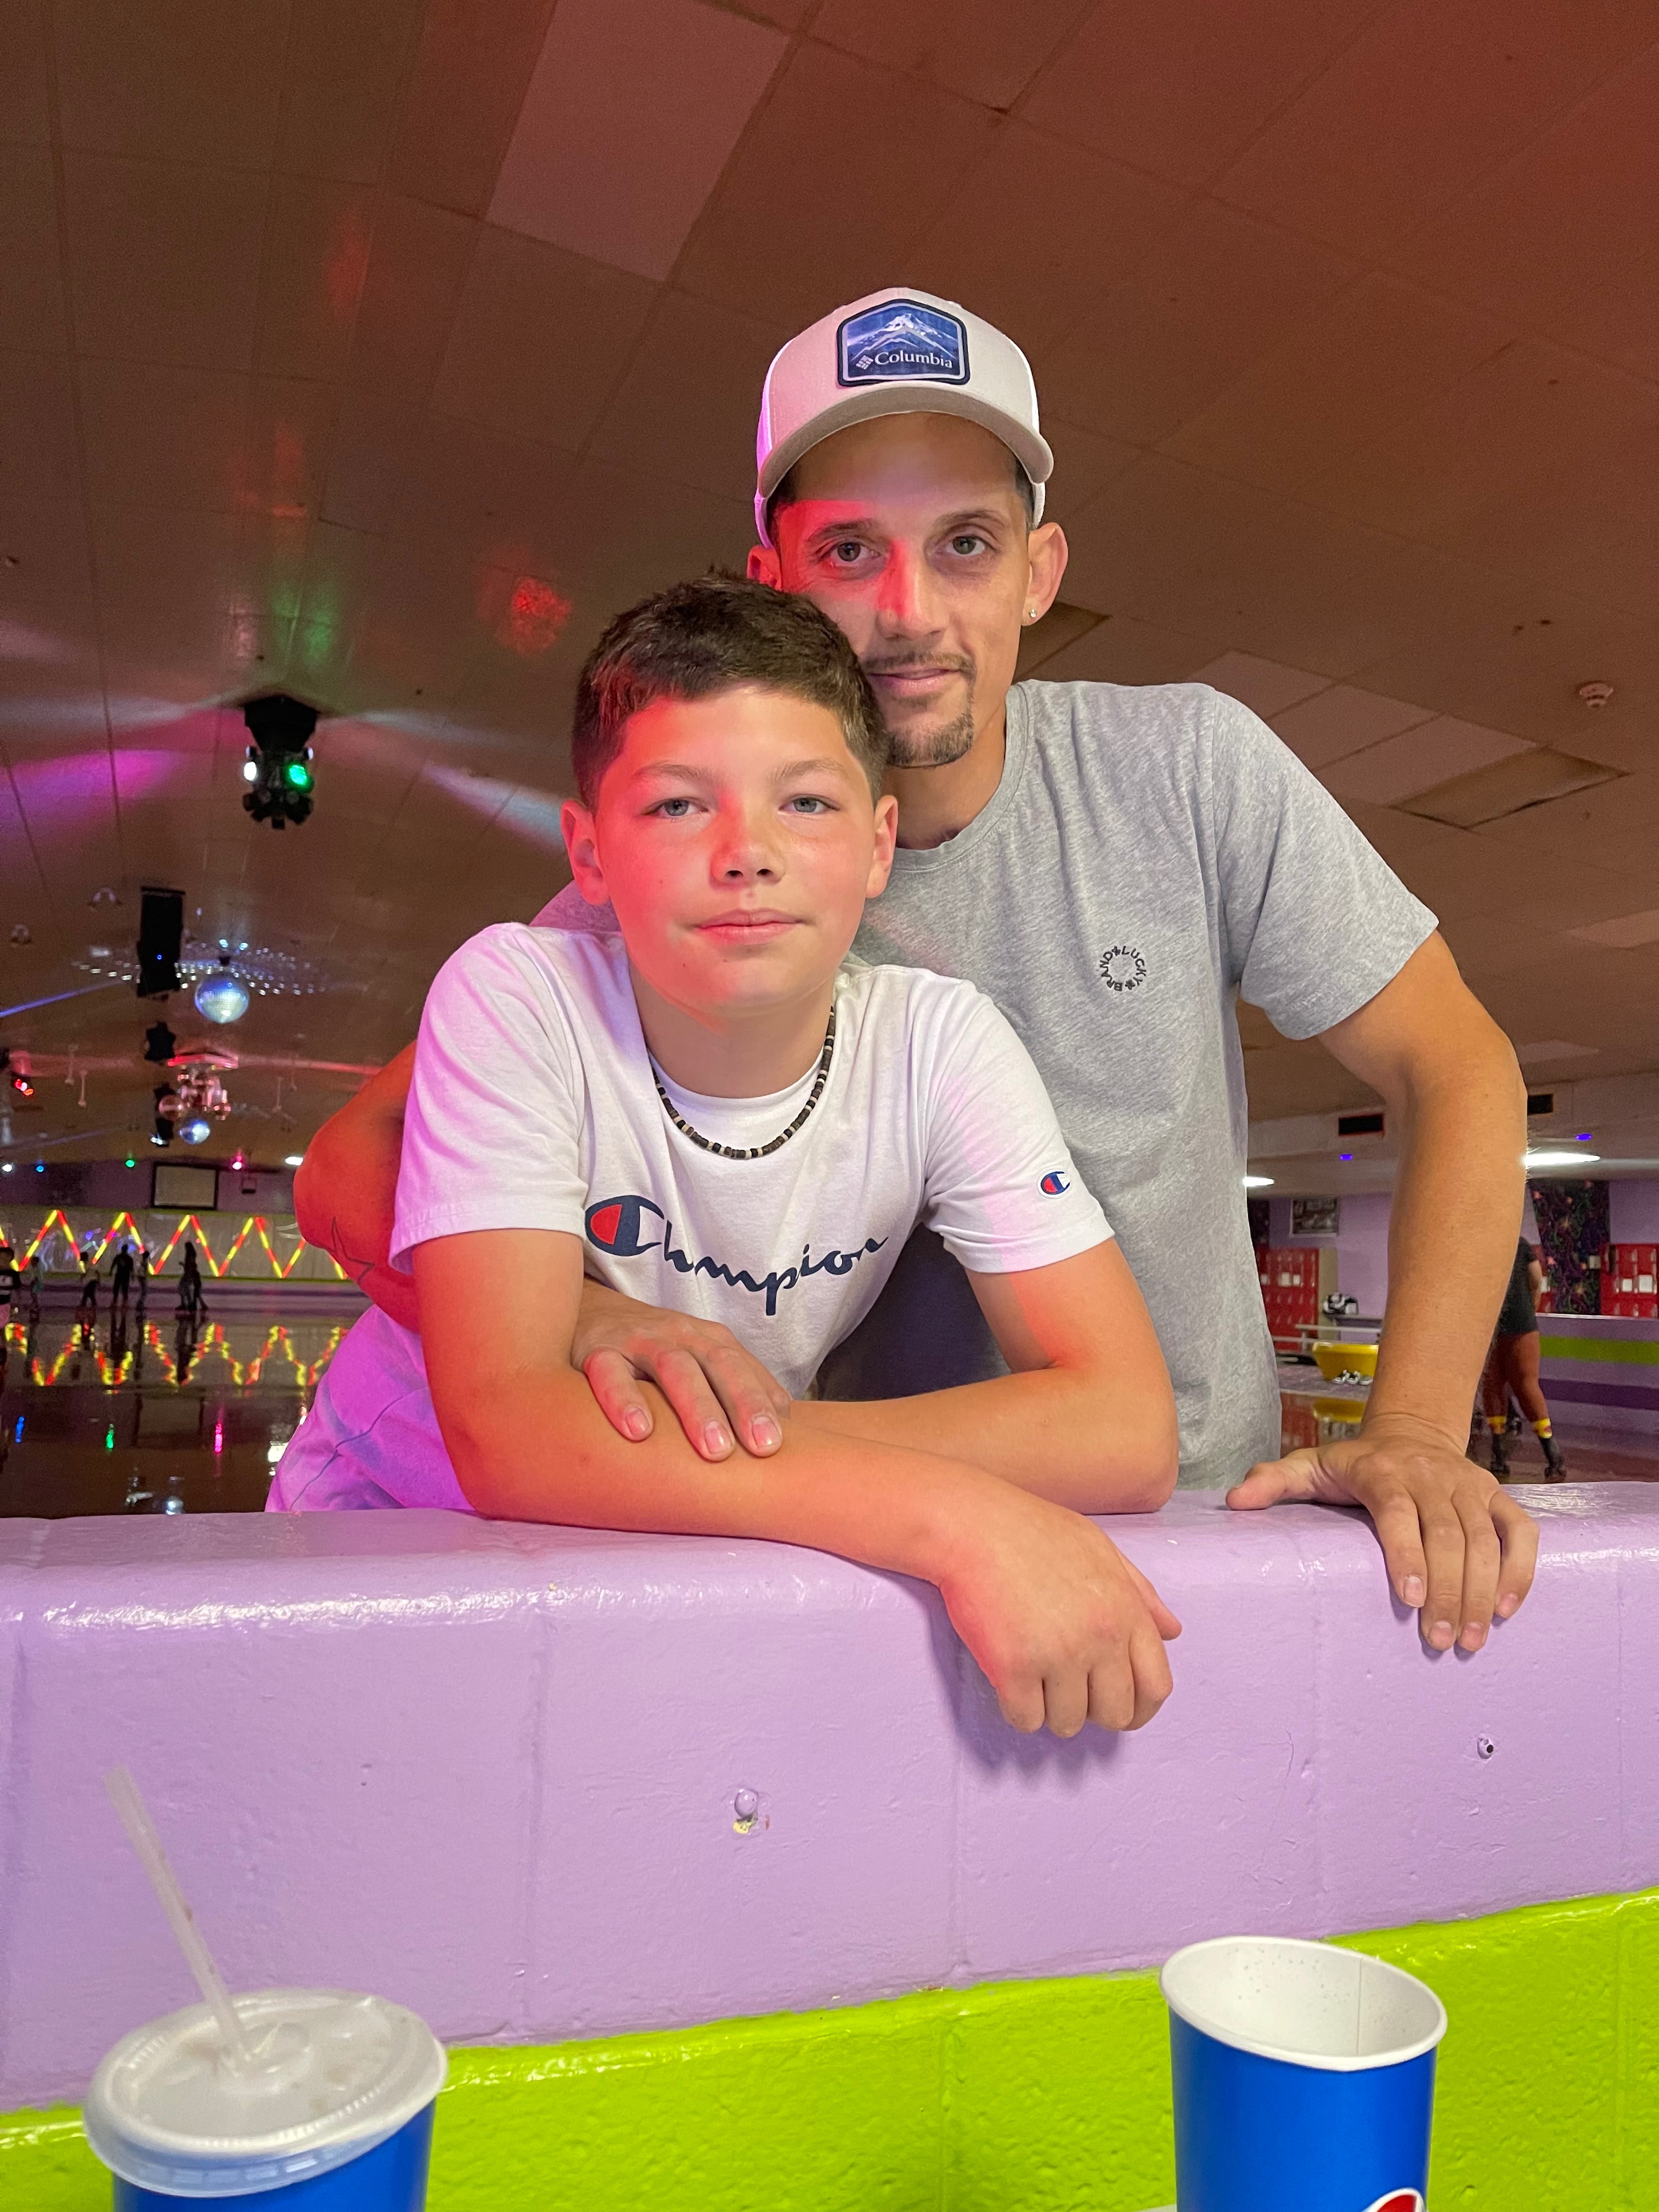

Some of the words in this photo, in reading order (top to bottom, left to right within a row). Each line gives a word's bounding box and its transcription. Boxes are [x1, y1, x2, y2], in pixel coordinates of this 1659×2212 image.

[874, 350, 952, 368] Columbia
[1121, 945, 1147, 986] LUCKY
[585, 1194, 889, 1316] Chmpion
